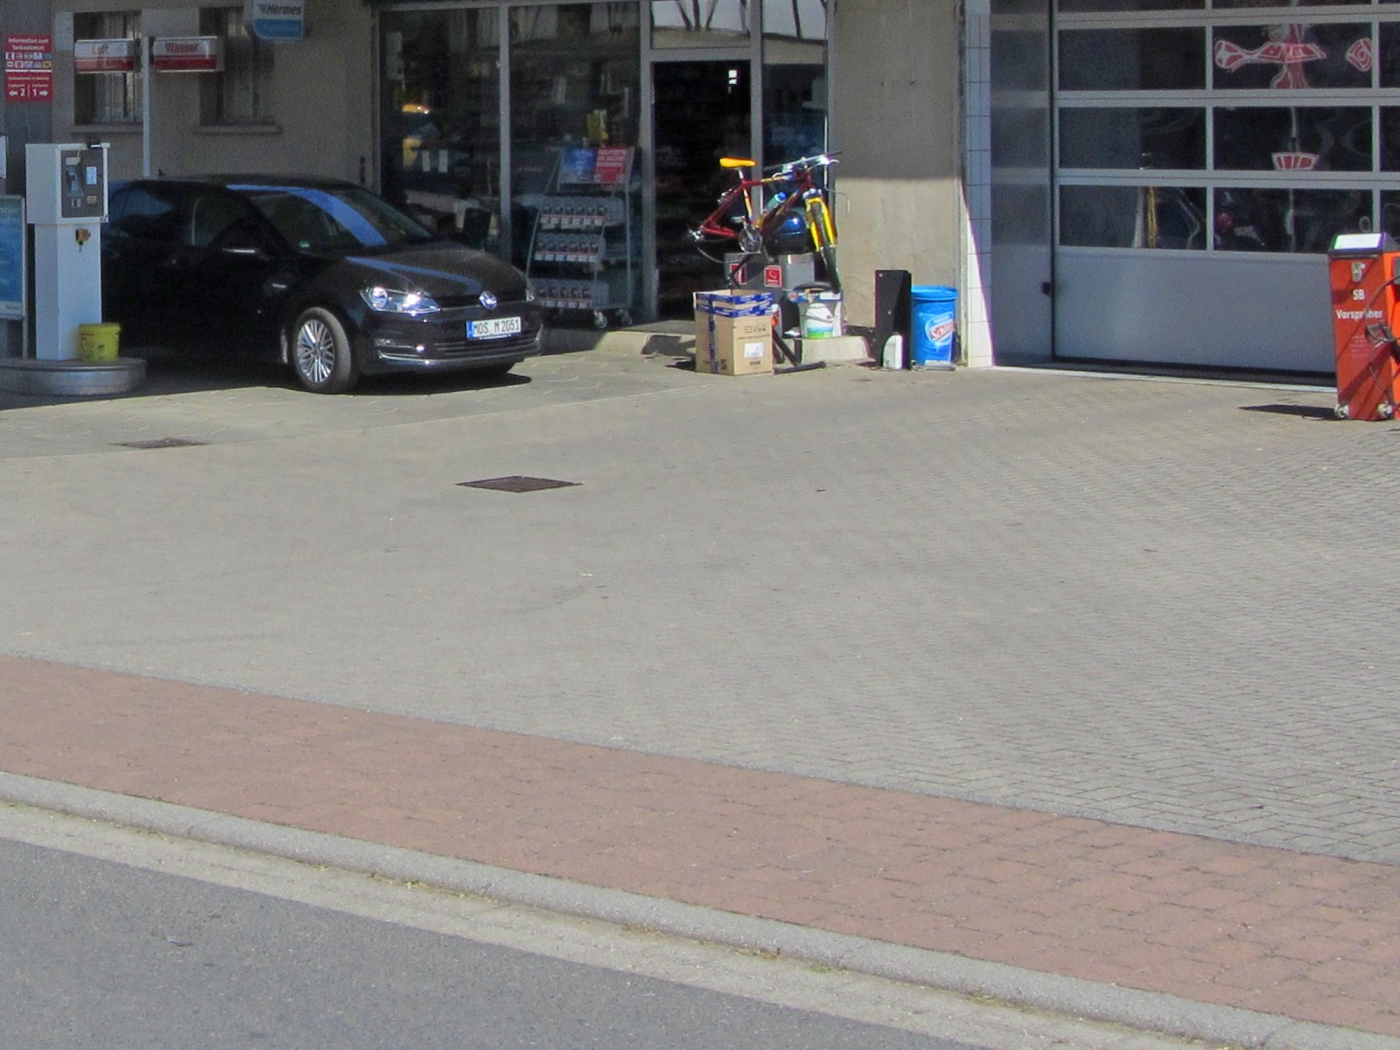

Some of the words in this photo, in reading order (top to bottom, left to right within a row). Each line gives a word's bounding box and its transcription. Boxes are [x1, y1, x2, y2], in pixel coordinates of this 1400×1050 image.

[266, 3, 302, 15] Hermes
[165, 42, 199, 53] Wasser
[20, 88, 26, 97] 2
[32, 88, 37, 97] 1
[1352, 288, 1366, 301] SB
